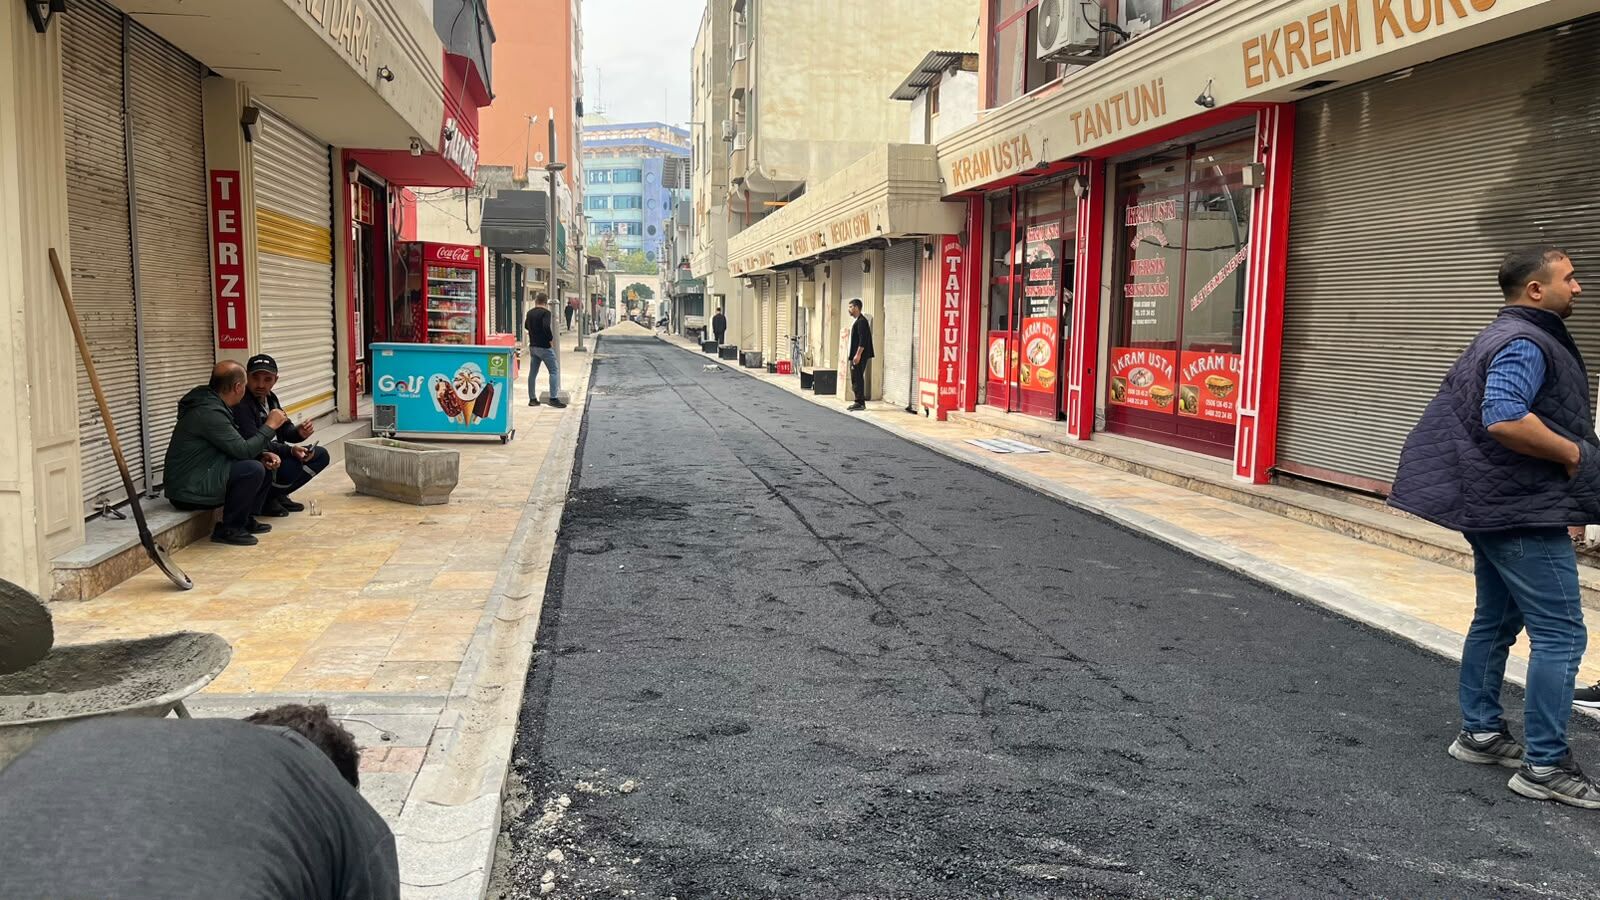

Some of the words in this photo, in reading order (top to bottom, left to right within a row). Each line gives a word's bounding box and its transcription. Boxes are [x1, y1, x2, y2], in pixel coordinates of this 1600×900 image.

[1242, 0, 1362, 89] EKREM
[1372, 0, 1497, 45] KUR
[993, 133, 1033, 173] USTA
[1148, 352, 1173, 379] USTA
